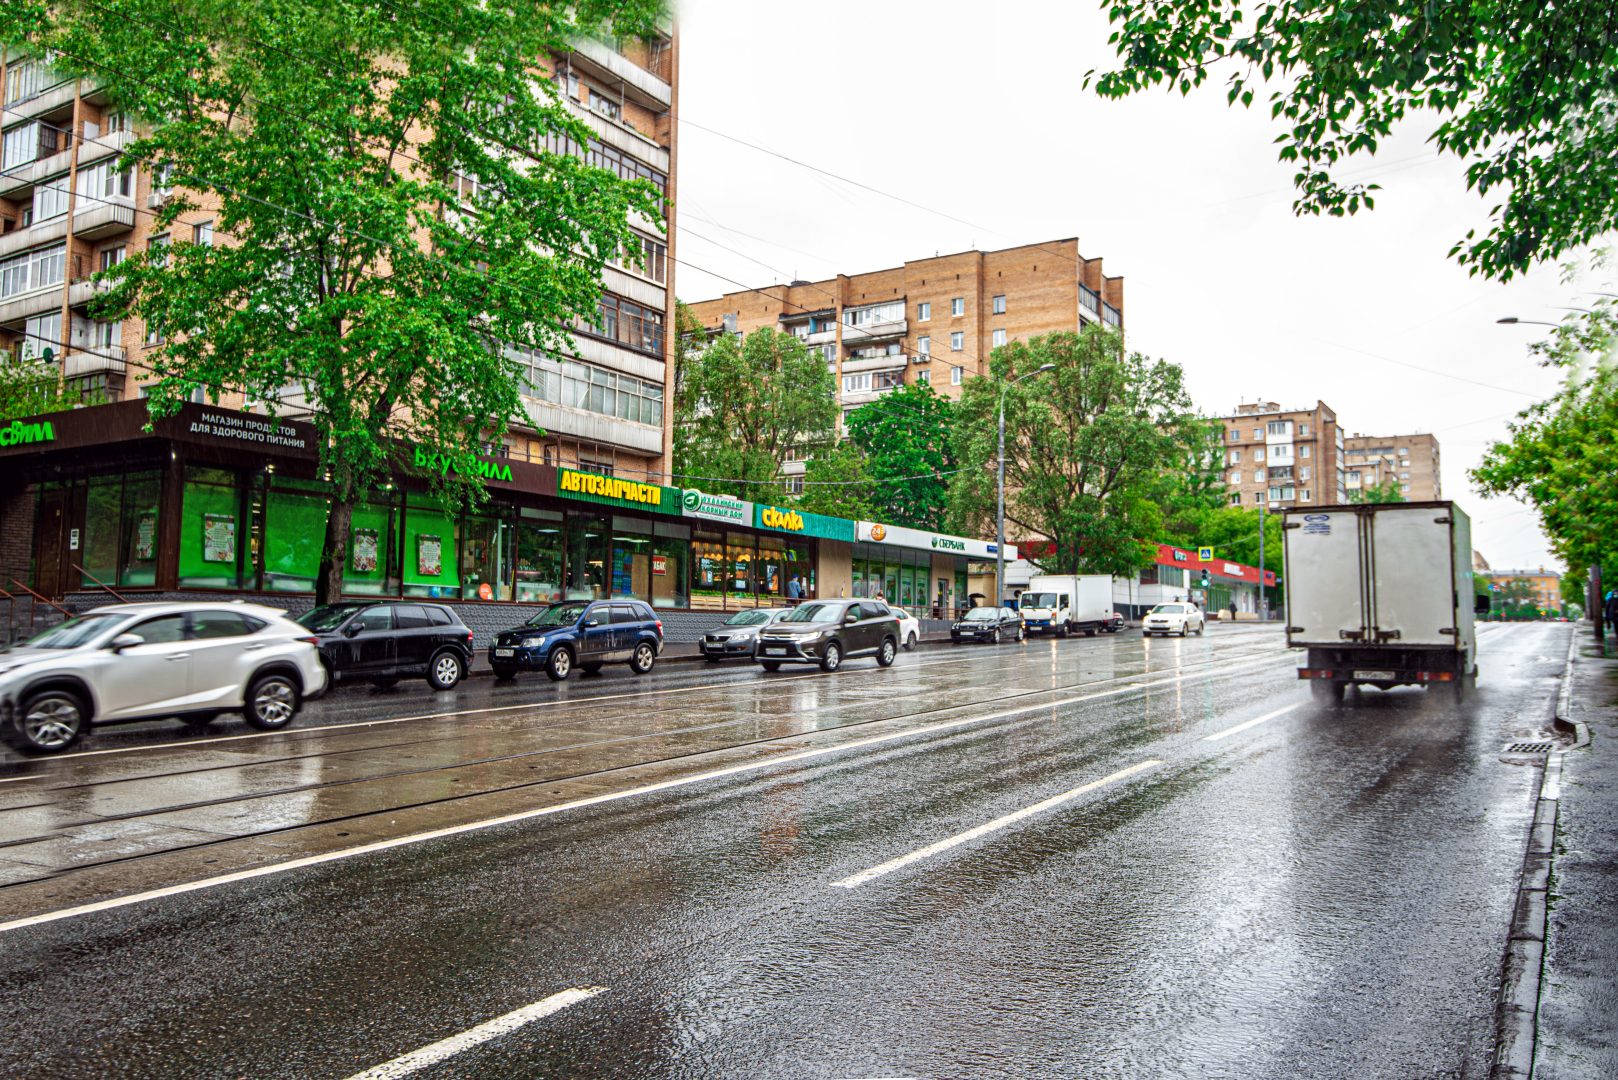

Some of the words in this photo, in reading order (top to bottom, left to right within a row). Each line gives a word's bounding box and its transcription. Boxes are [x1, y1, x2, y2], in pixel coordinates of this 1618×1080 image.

[202, 413, 243, 428] МАГАЗИН
[190, 422, 210, 434] ДЛЯ
[212, 426, 265, 442] ЗДОРОВОГО
[267, 434, 305, 449] ПИТАНИЯ
[560, 470, 661, 505] АВТОЗАПЧАСТИ
[702, 496, 744, 509] АХАЛИНСКИЙ
[729, 510, 743, 519] ДОМ
[938, 538, 966, 551] СБЕРБАНК
